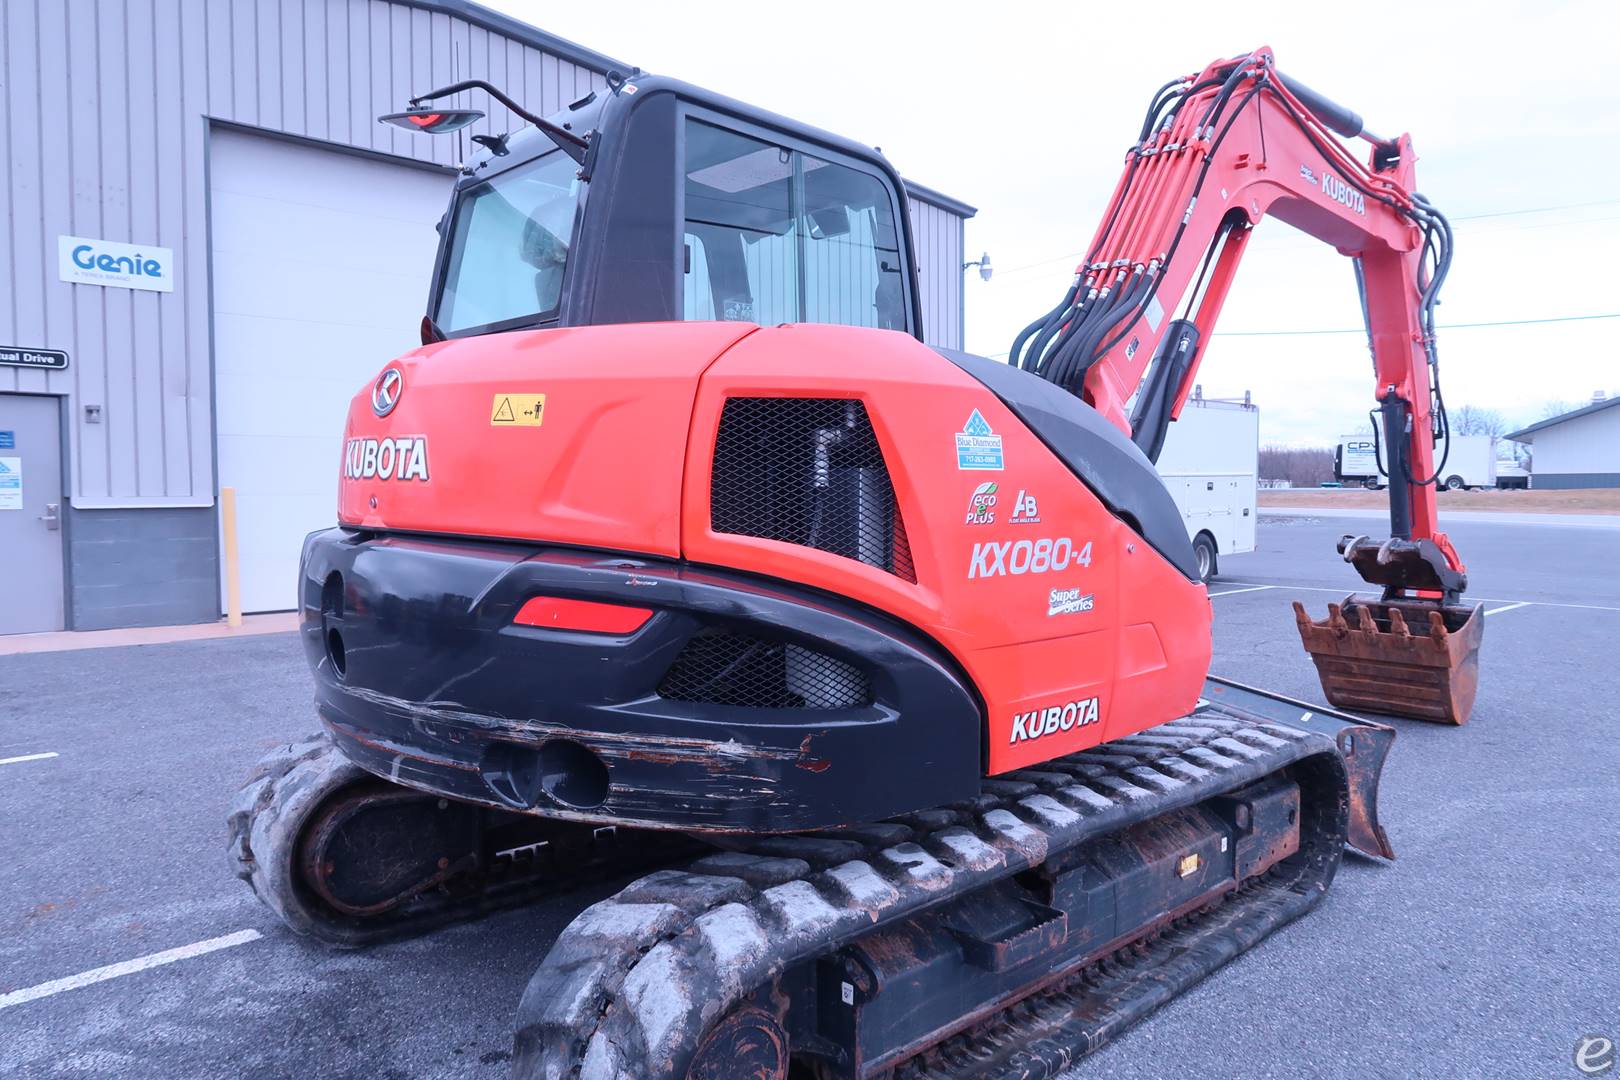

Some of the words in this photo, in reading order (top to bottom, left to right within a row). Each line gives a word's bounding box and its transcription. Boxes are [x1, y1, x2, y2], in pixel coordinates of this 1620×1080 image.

[1321, 172, 1366, 216] KUBOTA
[72, 244, 162, 277] Genie
[0, 352, 20, 361] ual
[22, 353, 56, 364] Drive
[957, 436, 972, 447] Blue
[972, 437, 1001, 448] Diamond
[343, 436, 430, 482] KUBOTA
[974, 495, 997, 506] eco
[965, 512, 995, 525] PLUS
[968, 537, 1093, 580] KX080-4
[1049, 588, 1080, 605] Super
[1063, 597, 1094, 613] Series
[1009, 696, 1100, 744] KUBOTA
